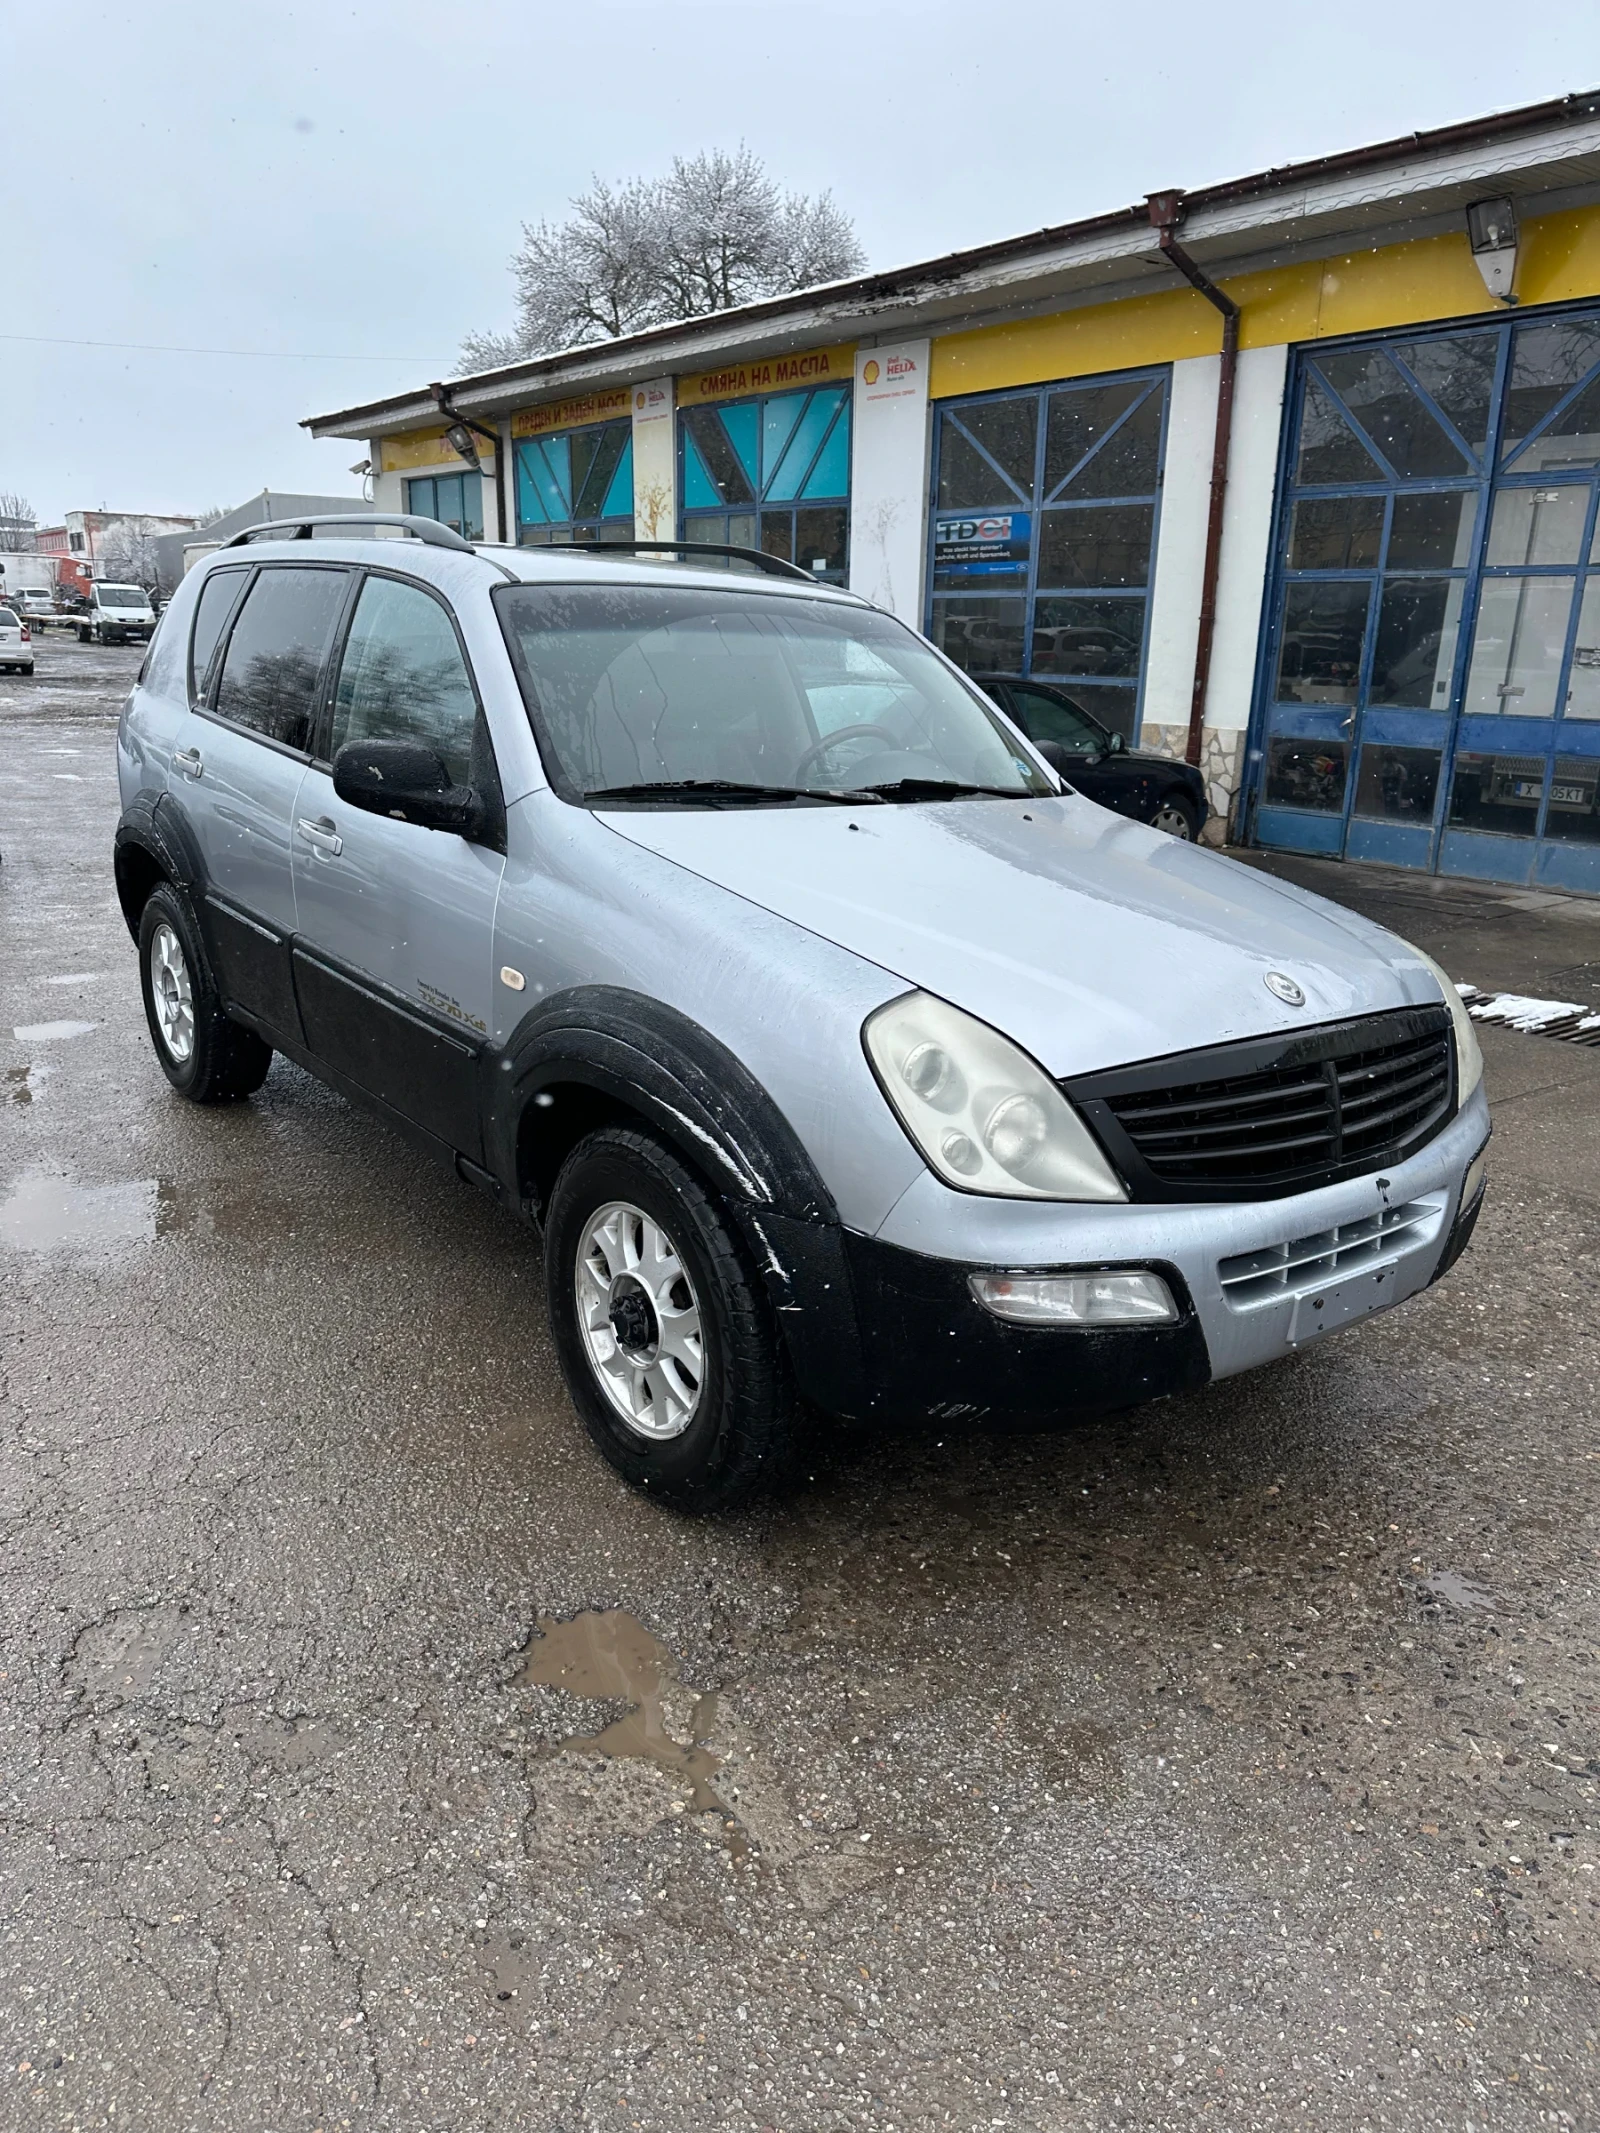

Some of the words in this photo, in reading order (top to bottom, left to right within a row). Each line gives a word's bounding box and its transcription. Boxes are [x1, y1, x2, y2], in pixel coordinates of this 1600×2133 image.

[700, 370, 747, 396] СМЯНА
[751, 365, 771, 387] НА
[775, 354, 830, 382] МАСЛА
[887, 362, 916, 375] HELIX
[518, 410, 551, 432] ПРЕДЕН
[553, 405, 562, 424] И
[563, 399, 595, 423] ЗАДЕН
[598, 393, 626, 414] МОСТ
[939, 518, 1009, 541] TDCi
[1566, 789, 1582, 801] KT
